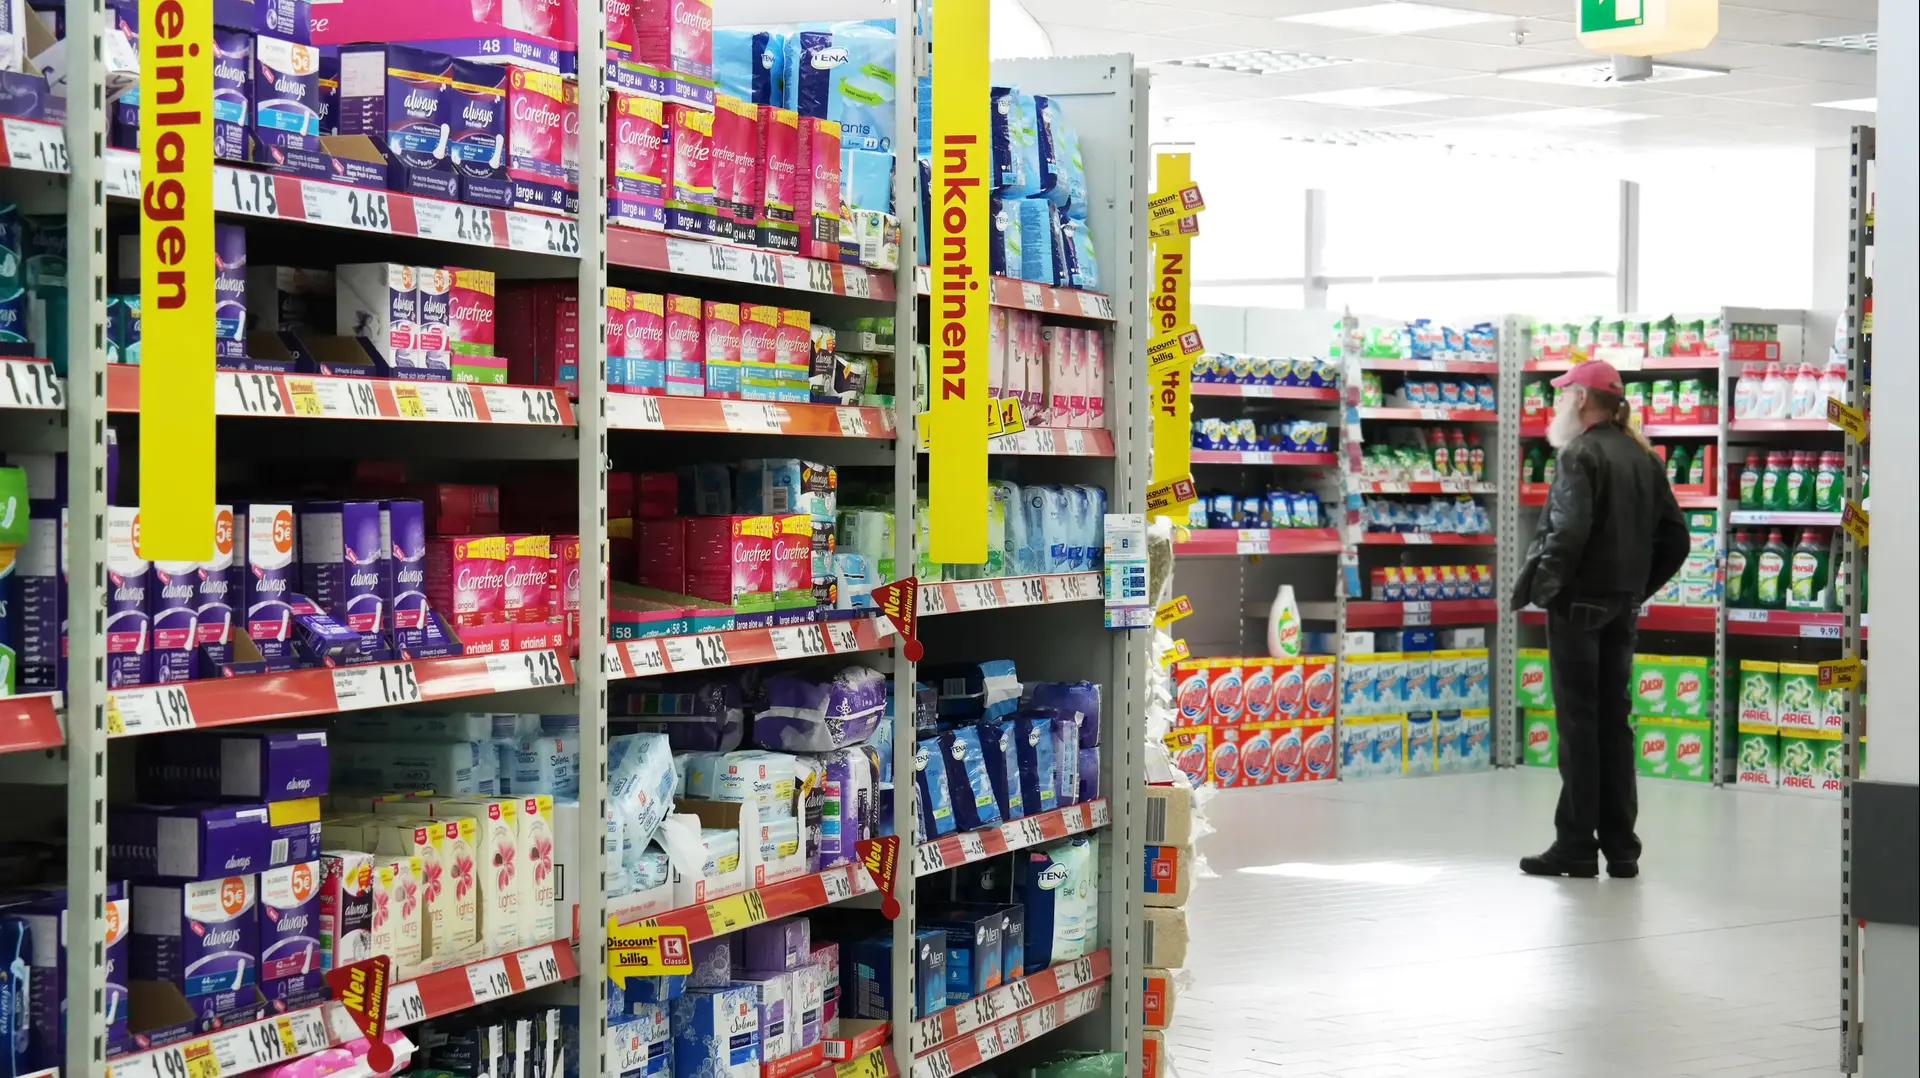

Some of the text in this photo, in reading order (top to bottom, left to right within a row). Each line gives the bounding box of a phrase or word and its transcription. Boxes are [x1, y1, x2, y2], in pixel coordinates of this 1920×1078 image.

[674, 3, 710, 31] Carefree
[482, 40, 500, 52] 48
[513, 39, 531, 56] large
[814, 54, 848, 64] TENA
[274, 74, 306, 100] always
[618, 71, 634, 87] large
[676, 80, 690, 97] large
[404, 89, 438, 118] always
[514, 98, 560, 128] Carefree
[462, 104, 493, 128] always
[620, 122, 660, 150] Carefree
[40, 140, 68, 170] 1.75
[770, 155, 794, 176] Carefree
[816, 164, 839, 184] Carefree
[232, 171, 276, 216] 1.75
[516, 184, 561, 204] large 48
[349, 192, 388, 228] 2.65
[621, 201, 662, 220] large 48
[677, 212, 693, 228] large
[1153, 206, 1174, 217] billig
[455, 208, 491, 242] 2.65
[545, 220, 579, 253] 2.25
[768, 234, 781, 247] long
[751, 252, 777, 283] 2.25
[808, 261, 831, 291] 2.25
[942, 135, 979, 400] Inkontinenz
[393, 293, 415, 317] always
[424, 296, 447, 320] always
[449, 298, 492, 324] Carefree
[626, 319, 662, 342] Carefree
[669, 320, 700, 344] Carefree
[709, 327, 739, 348] Carefree
[742, 330, 775, 350] Carefree
[776, 332, 808, 353] Carefree
[1152, 351, 1174, 363] billig
[5, 362, 61, 406] 1.75
[234, 374, 281, 412] 1.75
[348, 382, 377, 416] 1.99
[448, 385, 474, 418] 1.99
[522, 390, 559, 423] 2.25
[216, 520, 232, 541] 5€
[276, 520, 291, 540] 5€
[734, 542, 771, 563] Carefree
[775, 541, 809, 561] Carefree
[398, 568, 423, 589] always
[504, 566, 548, 588] Carefree
[1760, 563, 1779, 572] Persil
[1792, 564, 1814, 573] Persil
[200, 578, 228, 599] always
[256, 577, 286, 598] always
[351, 571, 379, 592] always
[458, 568, 503, 591] Carefree
[114, 586, 144, 607] always
[162, 582, 194, 606] always
[885, 586, 900, 618] Neu
[924, 587, 944, 611] 3.45
[975, 581, 996, 606] 3.45
[1022, 580, 1043, 602] 3.45
[616, 626, 631, 638] 58
[798, 624, 824, 654] 2.25
[1820, 627, 1839, 635] 9.99
[466, 638, 509, 654] original 58
[521, 635, 562, 650] original 58
[696, 637, 728, 666] 2.25
[524, 649, 561, 686] 2.25
[646, 650, 662, 668] 2.25
[380, 663, 418, 702] 1.75
[156, 689, 190, 726] 1.99
[1742, 710, 1772, 721] ARIEL
[1782, 713, 1814, 725] ARIEL
[952, 745, 966, 753] TENA
[1740, 772, 1770, 784] ARIEL
[1783, 777, 1815, 789] ARIEL
[1020, 820, 1042, 844] 5.95
[225, 856, 250, 870] always
[865, 841, 882, 873] Neu
[921, 843, 942, 872] 3.45
[294, 870, 311, 894] 5€
[1038, 872, 1068, 882] TENA
[223, 884, 243, 907] 5€
[1063, 887, 1074, 897] Bed
[742, 890, 766, 922] 1.99
[277, 913, 309, 934] always
[1010, 923, 1021, 932] Men
[203, 928, 240, 949] always
[607, 937, 657, 947] Discount-
[986, 927, 1000, 943] Men
[620, 952, 648, 966] billig
[930, 952, 944, 964] Men
[539, 958, 558, 982] 1.99
[1073, 957, 1091, 984] 4.39
[343, 967, 366, 1012] Neu
[369, 969, 384, 1020] Sortiment
[490, 972, 510, 995] 1.99
[1010, 979, 1033, 1008] 5.25
[402, 995, 424, 1020] 1.99
[975, 995, 995, 1024] 5.25
[1039, 1004, 1055, 1031] 4.39
[306, 1020, 326, 1048] 1.99
[366, 1025, 376, 1036] im
[730, 1018, 756, 1034] Solena
[921, 1014, 942, 1048] 5.25
[249, 1023, 281, 1064] 1.99
[621, 1055, 646, 1069] Solena
